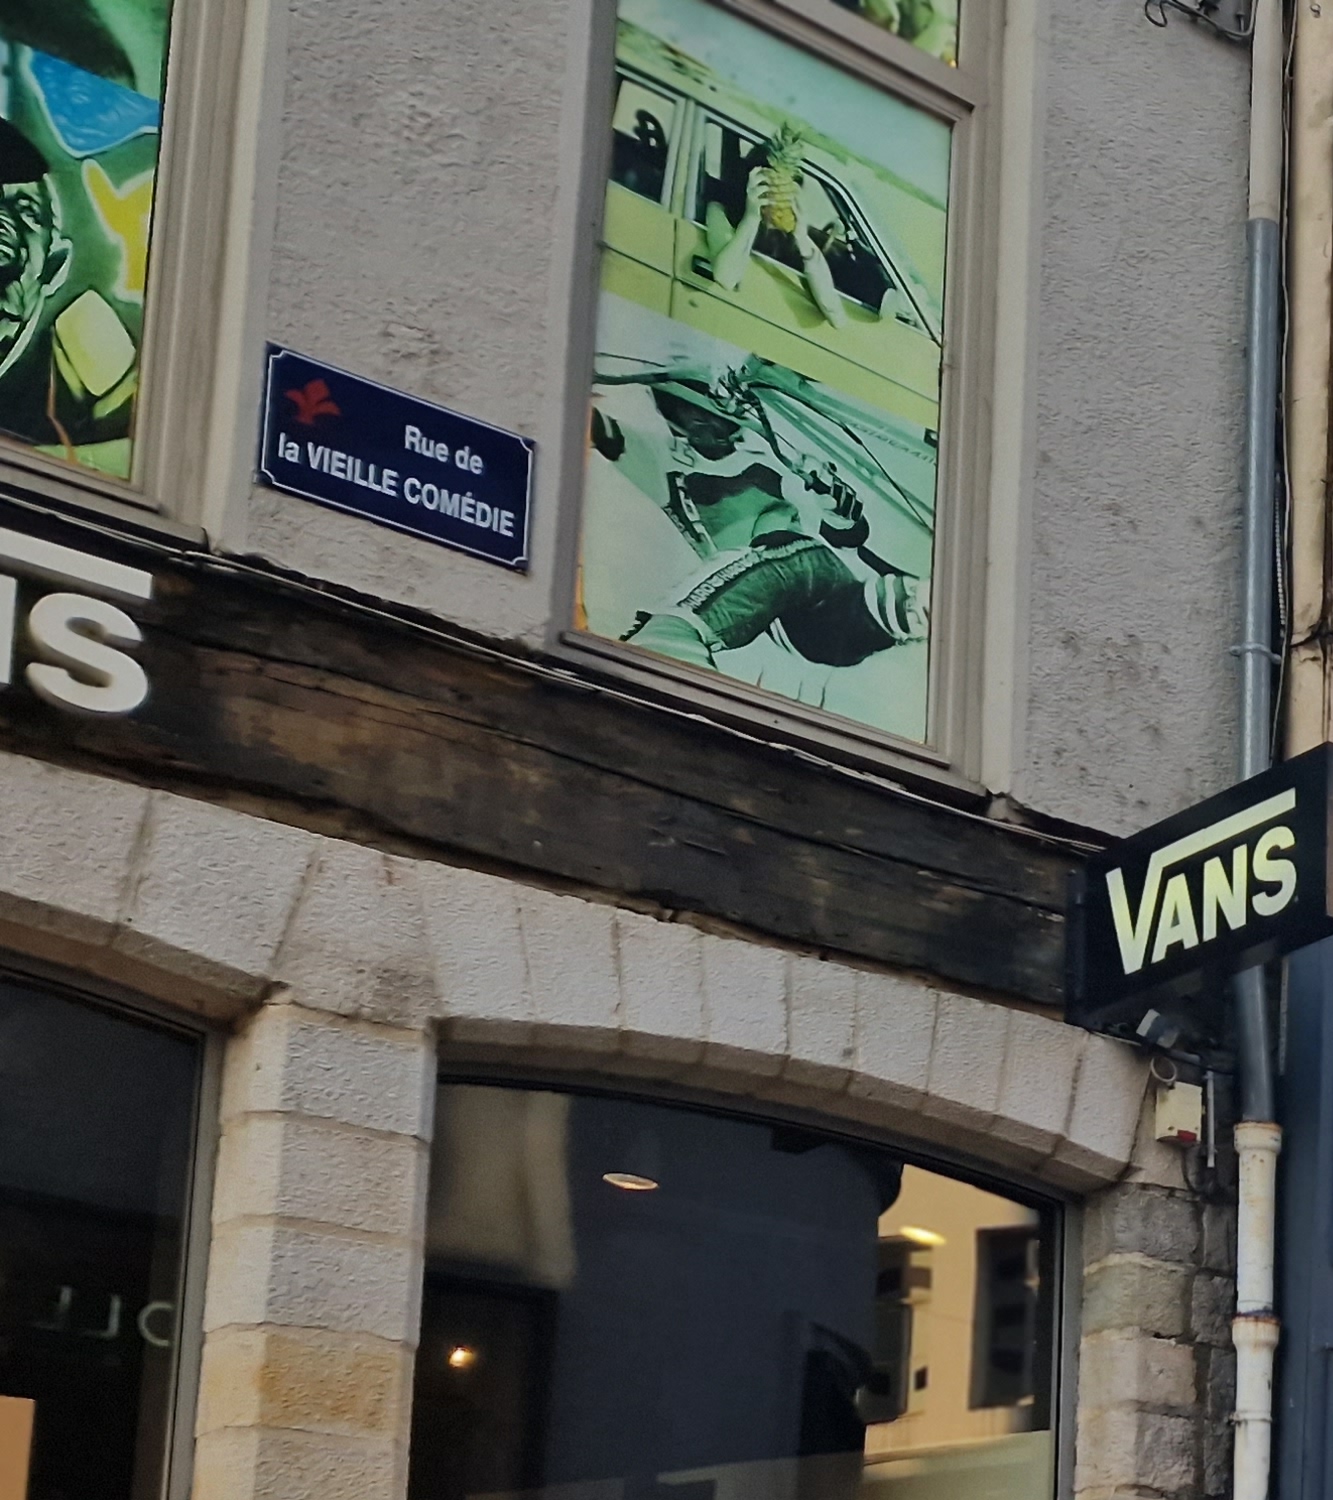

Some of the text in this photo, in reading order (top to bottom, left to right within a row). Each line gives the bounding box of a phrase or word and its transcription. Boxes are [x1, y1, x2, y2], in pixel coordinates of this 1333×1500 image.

[278, 432, 515, 538] la VIEILLE COMÉDIE
[404, 424, 485, 475] Rue de
[1105, 787, 1296, 975] VANS
